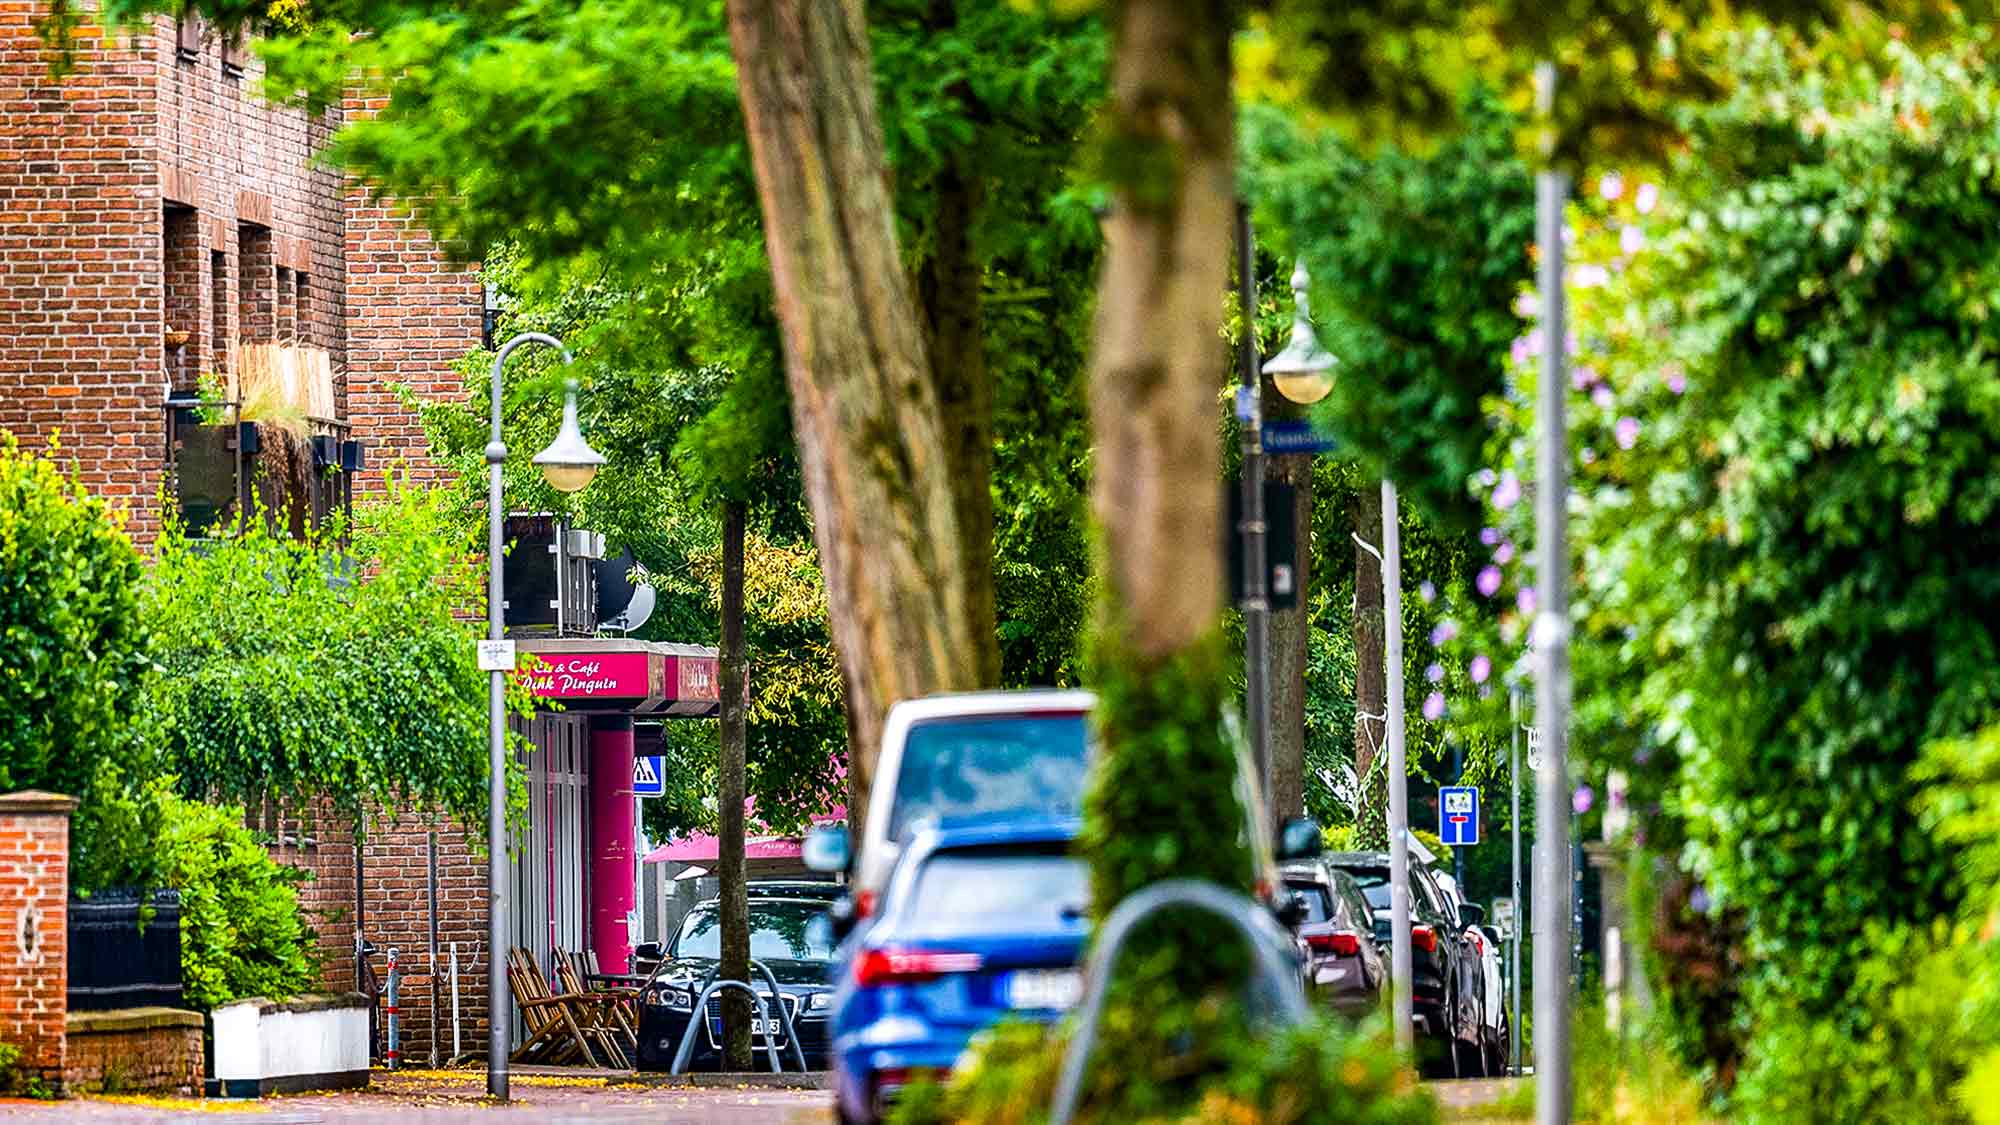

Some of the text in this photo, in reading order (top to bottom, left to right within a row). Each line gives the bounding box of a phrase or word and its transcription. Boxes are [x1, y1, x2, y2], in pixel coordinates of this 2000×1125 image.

[554, 663, 565, 673] &
[568, 660, 601, 677] Café
[558, 674, 617, 694] Pinguin
